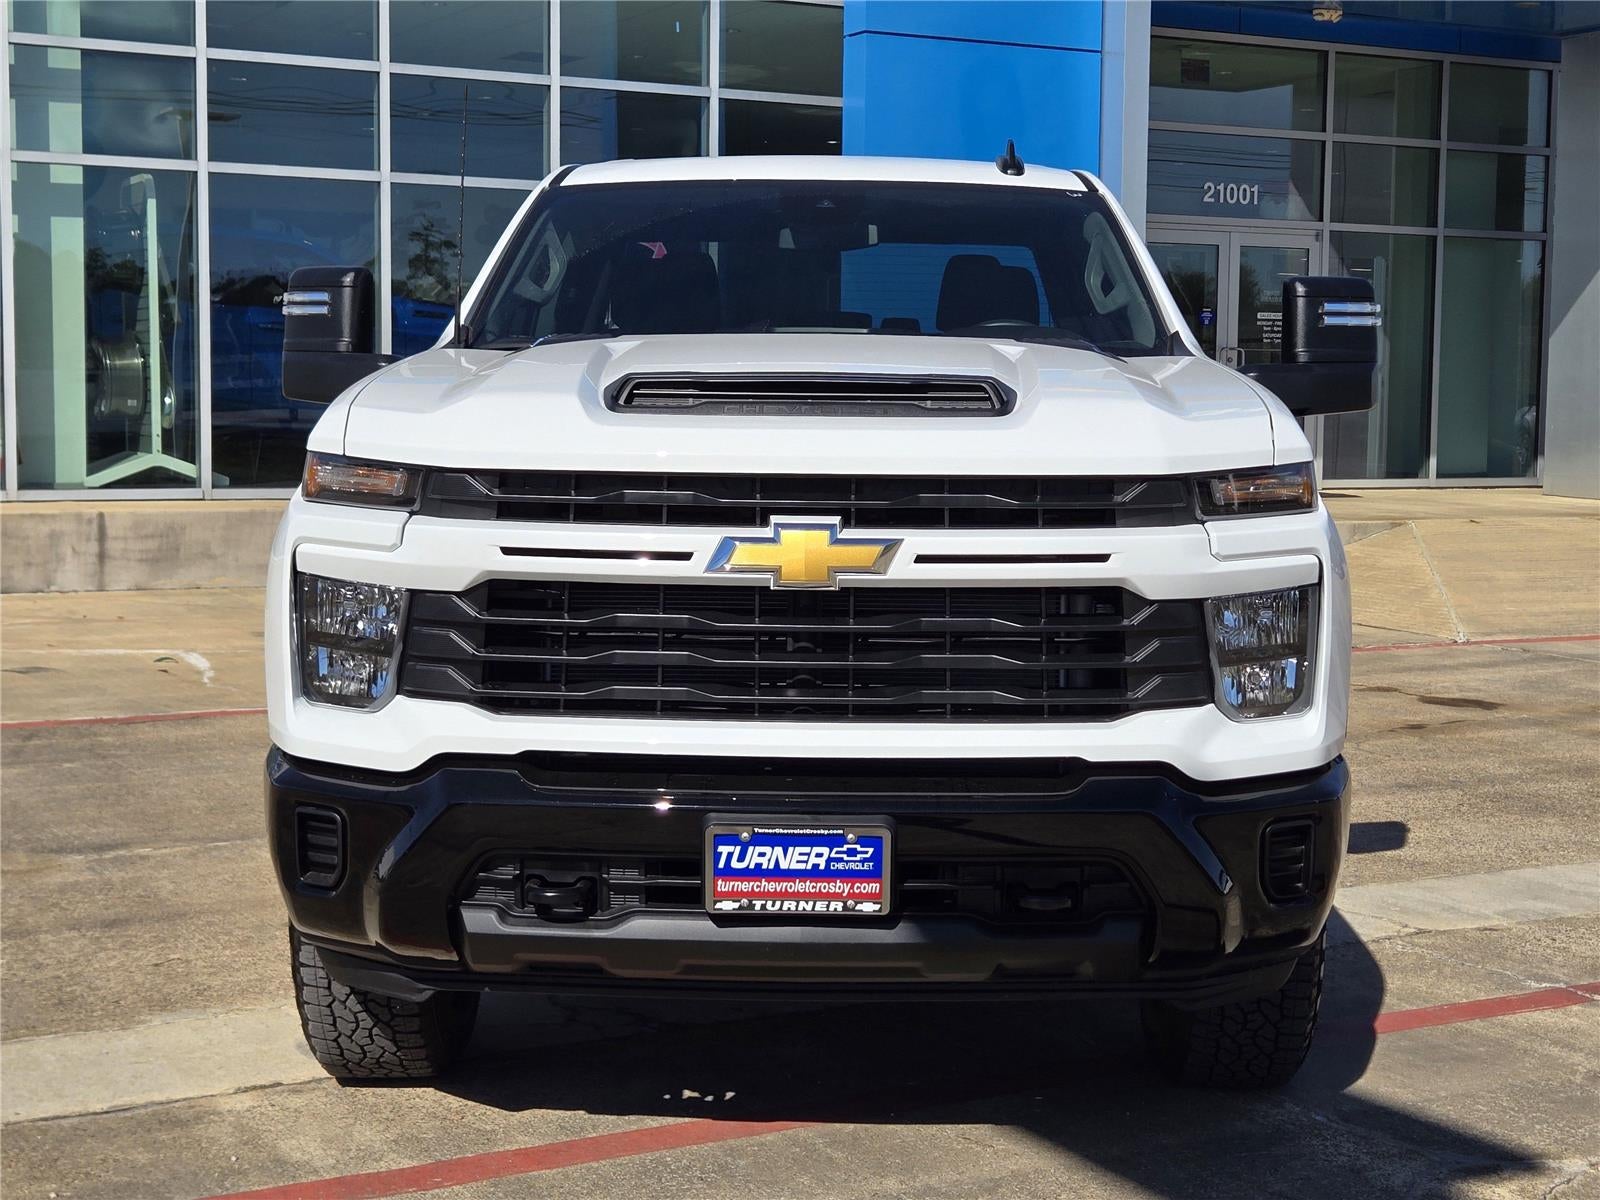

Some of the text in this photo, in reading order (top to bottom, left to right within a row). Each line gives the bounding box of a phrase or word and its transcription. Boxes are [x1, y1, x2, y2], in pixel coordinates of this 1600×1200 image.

[1203, 182, 1259, 205] 21001
[753, 827, 844, 835] TurnerChevroletCrosby.com
[716, 845, 830, 870] TURNER
[830, 862, 874, 870] CHEVROLET
[716, 878, 880, 897] turnerchevroletcrosby.com
[752, 900, 844, 911] TURNER
